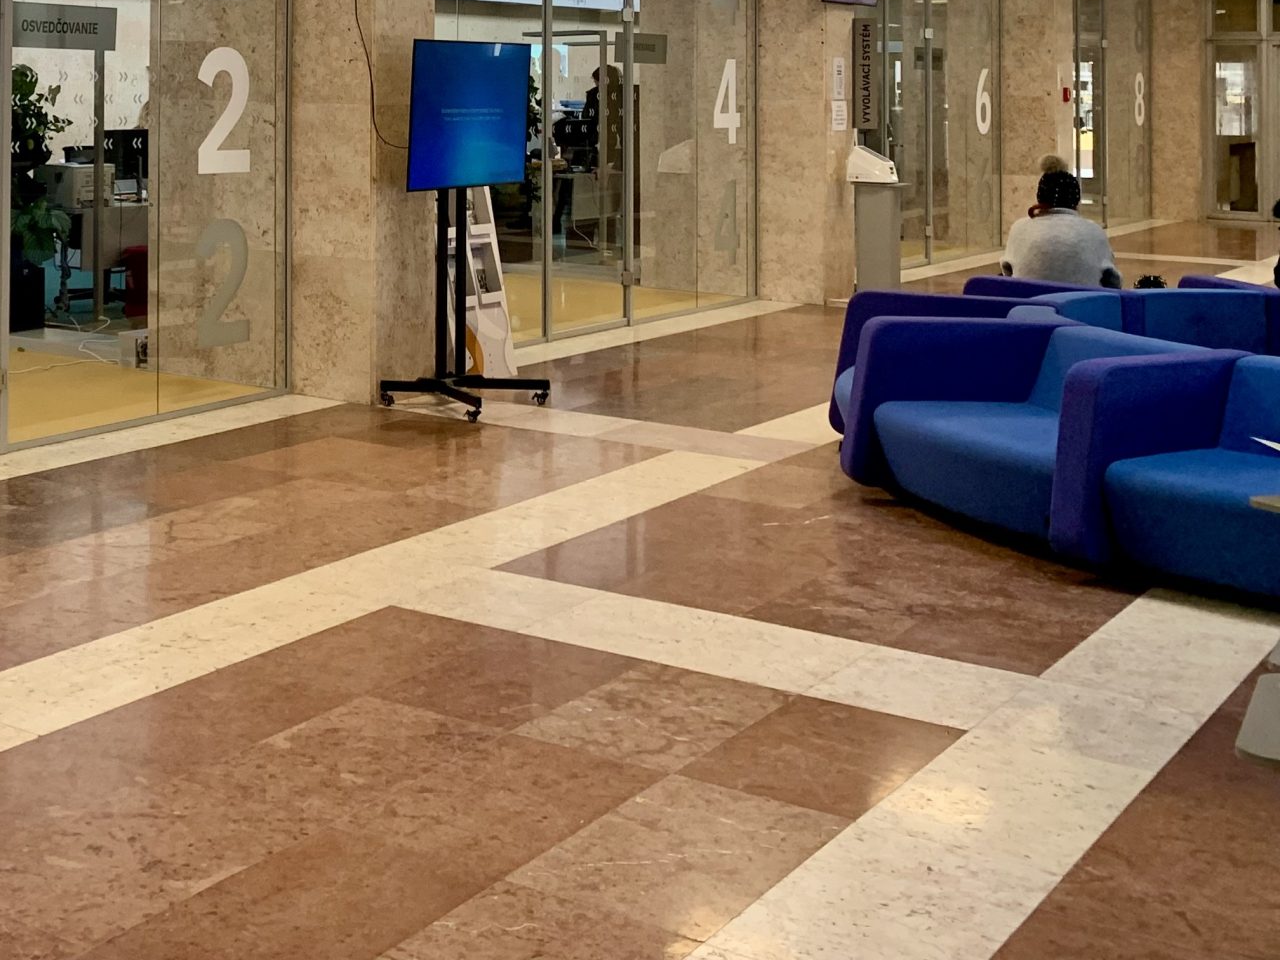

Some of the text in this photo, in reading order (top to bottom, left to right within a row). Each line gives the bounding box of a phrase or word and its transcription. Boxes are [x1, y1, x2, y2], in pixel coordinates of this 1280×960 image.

[21, 17, 99, 35] OSVEDČOVANIE
[197, 47, 251, 175] 2
[713, 58, 741, 145] 4
[859, 24, 871, 123] VYVOLÁVACÍ SYSTÉM
[976, 68, 992, 135] 6
[1134, 72, 1145, 126] 8
[197, 218, 250, 347] 2
